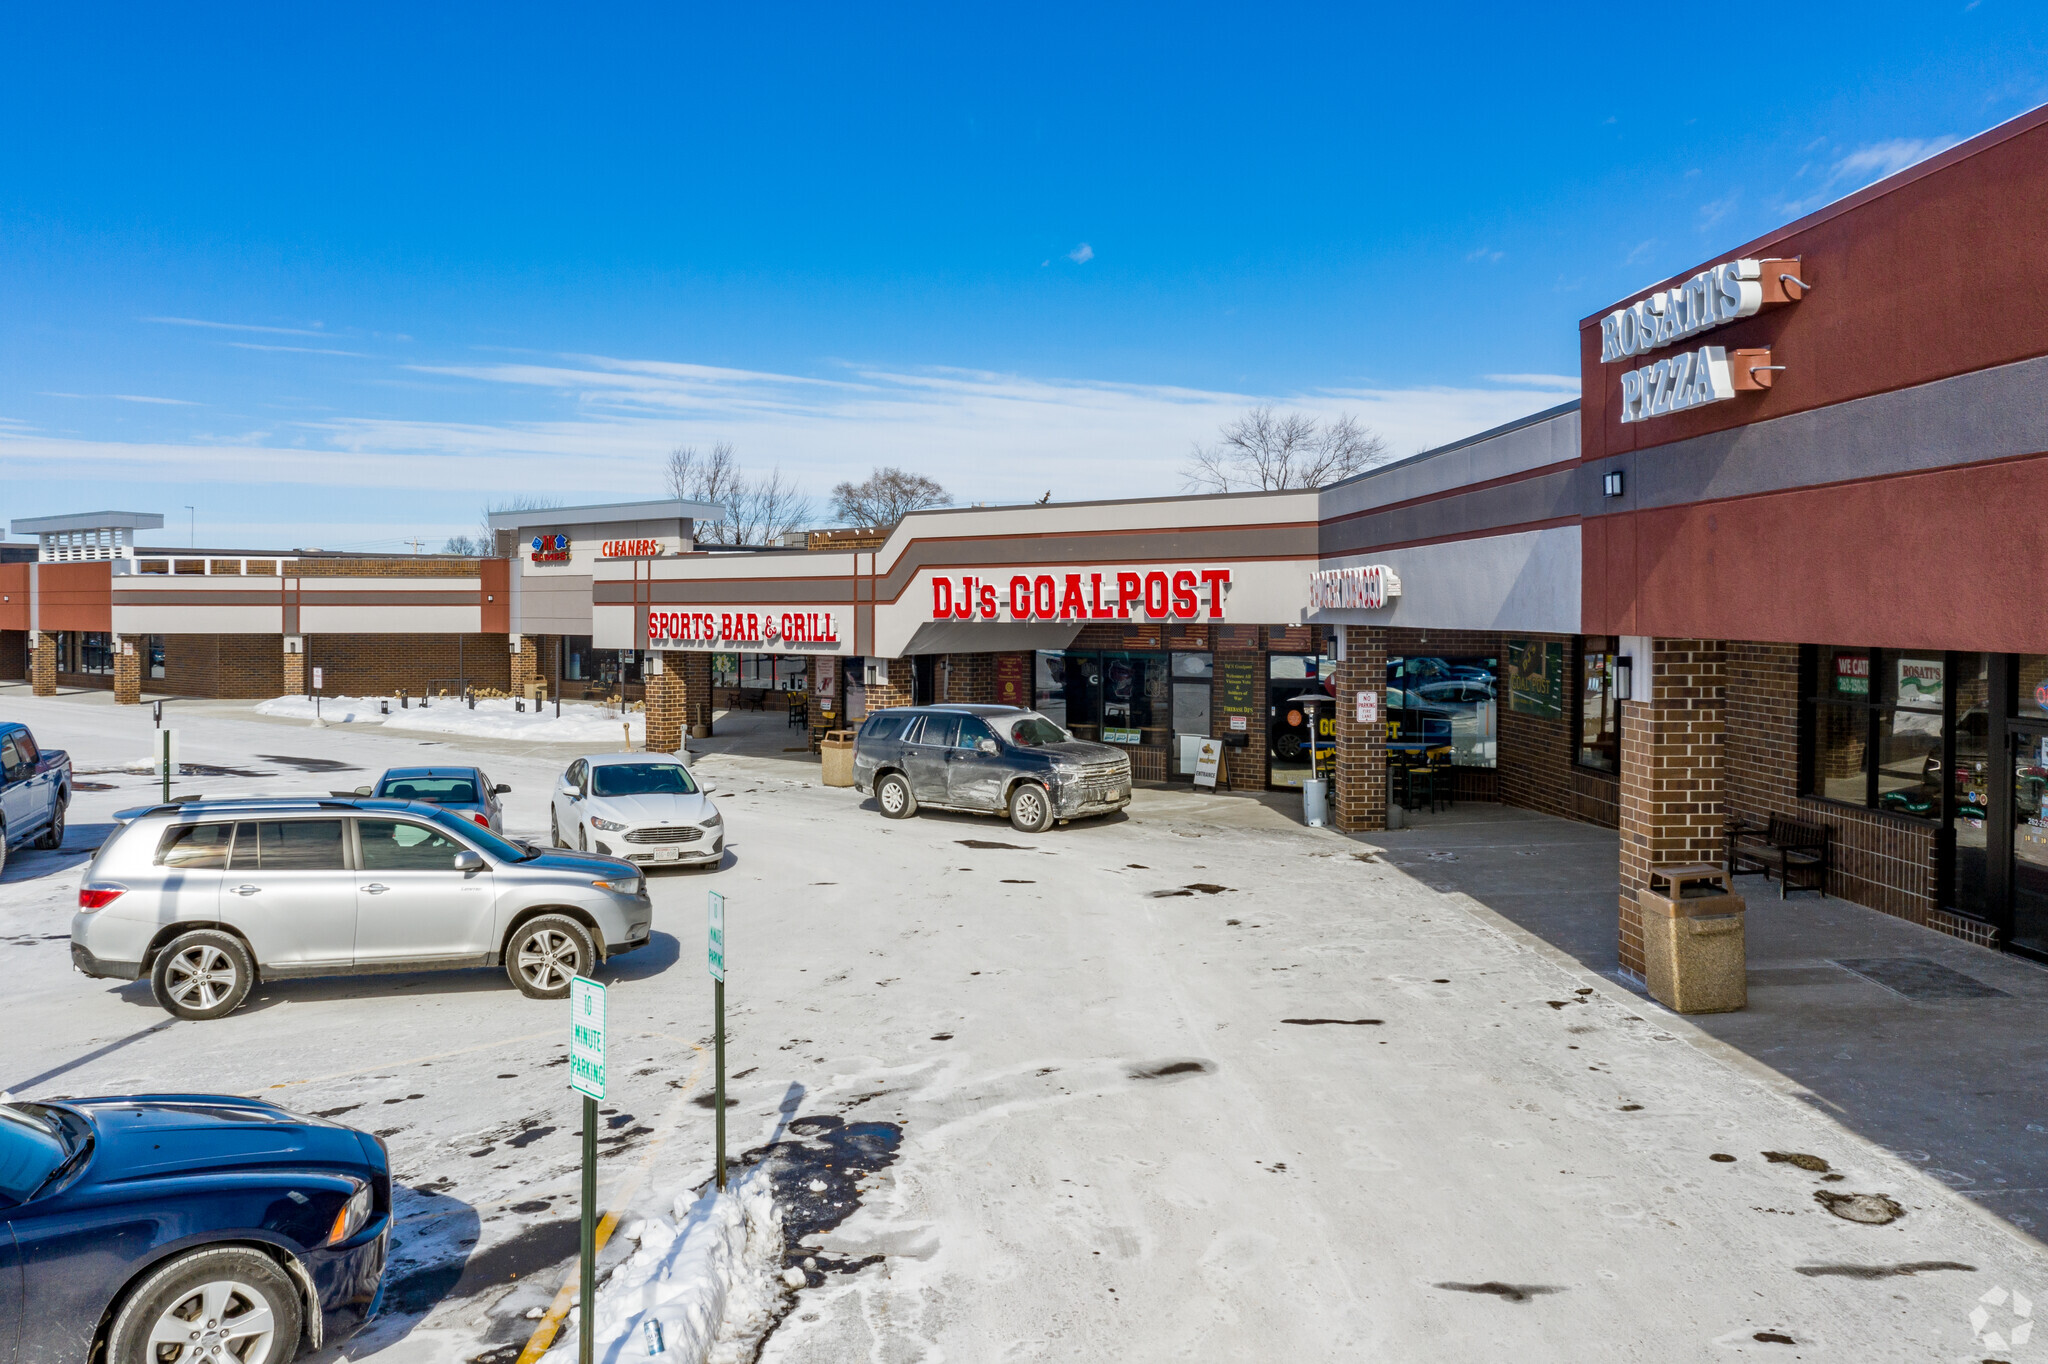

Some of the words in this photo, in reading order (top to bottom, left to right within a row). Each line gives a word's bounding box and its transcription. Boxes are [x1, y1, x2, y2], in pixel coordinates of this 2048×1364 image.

[1600, 260, 1755, 364] ROSATI'S
[1620, 345, 1725, 424] PIZZA
[531, 551, 568, 563] GAMES
[602, 539, 657, 558] CLEANERS
[931, 575, 998, 620] DJ's
[1009, 568, 1232, 620] GOALPOST
[648, 612, 715, 641] SPORTS
[721, 613, 760, 642] BAR
[764, 614, 778, 640] &
[781, 612, 838, 643] GRILL
[1839, 658, 1852, 675] WE
[1902, 664, 1941, 680] ROSATI'S
[1196, 770, 1216, 779] ENTRANCE
[584, 993, 593, 1016] 10
[574, 1023, 602, 1053] MINUTE
[570, 1053, 605, 1086] PARKING
